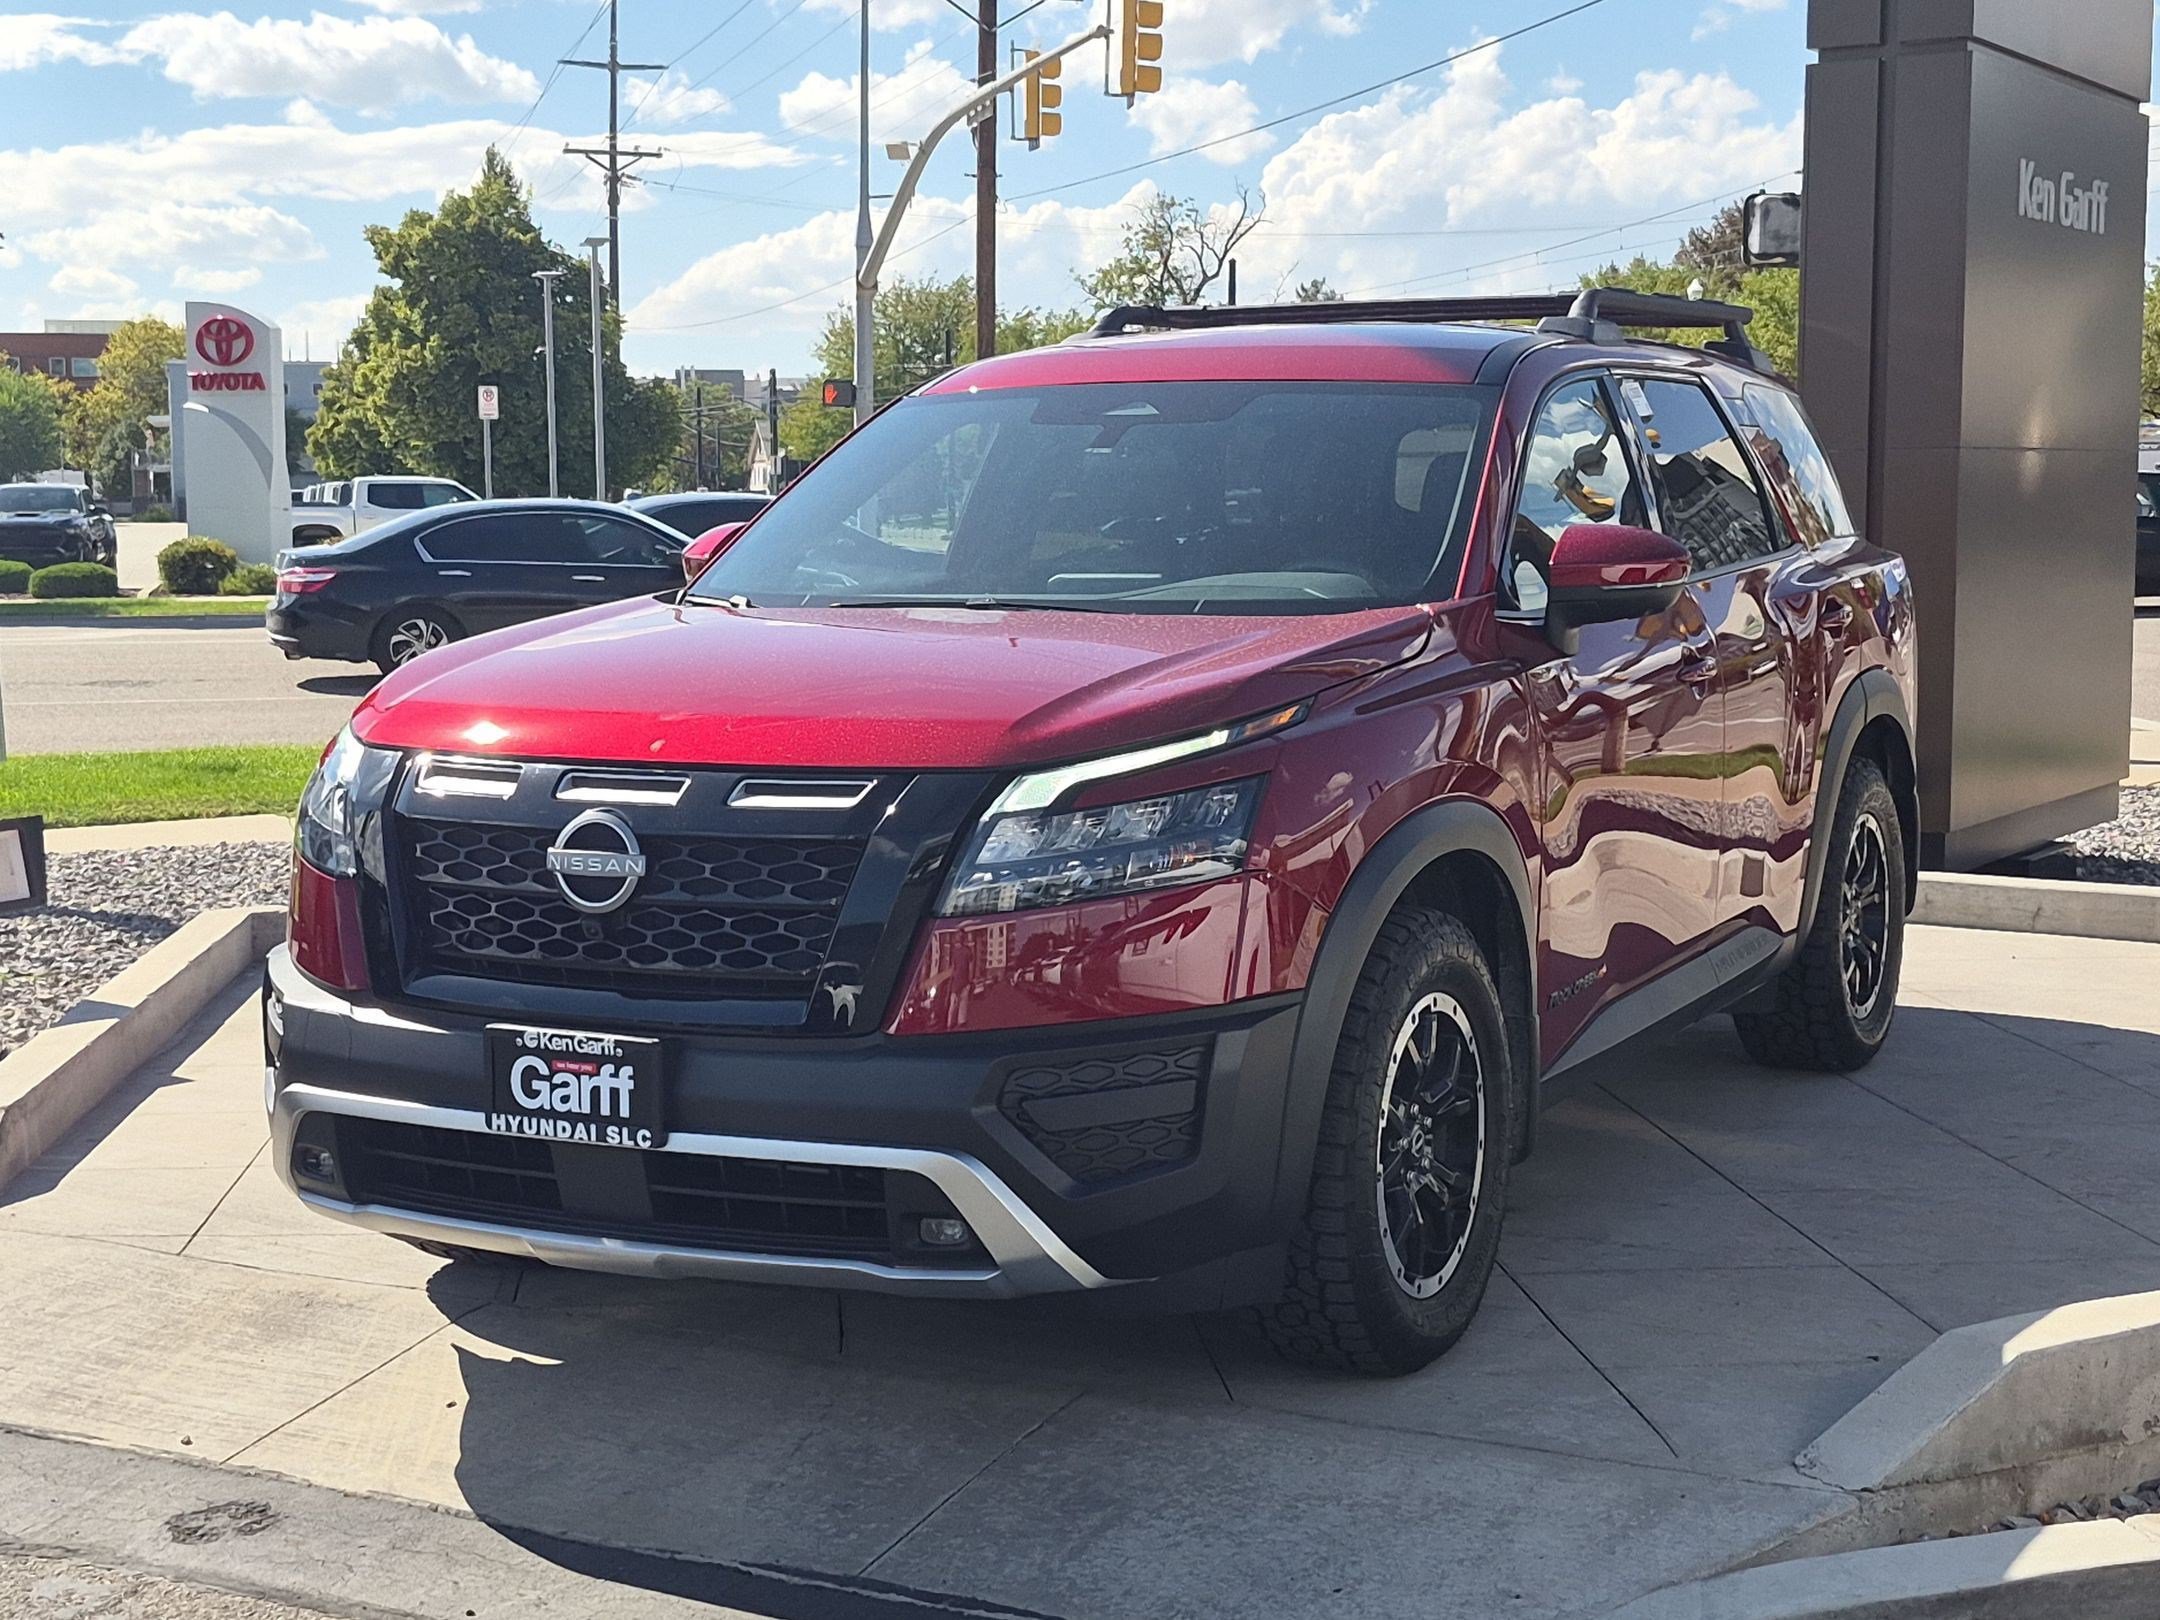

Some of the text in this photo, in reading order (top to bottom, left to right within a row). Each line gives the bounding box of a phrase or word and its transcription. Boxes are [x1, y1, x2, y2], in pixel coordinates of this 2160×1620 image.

[2018, 158, 2109, 234] Ken Garff
[187, 371, 266, 391] TOYOTA
[547, 854, 643, 874] NISSAN
[510, 1055, 635, 1119] Garff
[491, 1113, 653, 1149] HYUNDAI SLC
